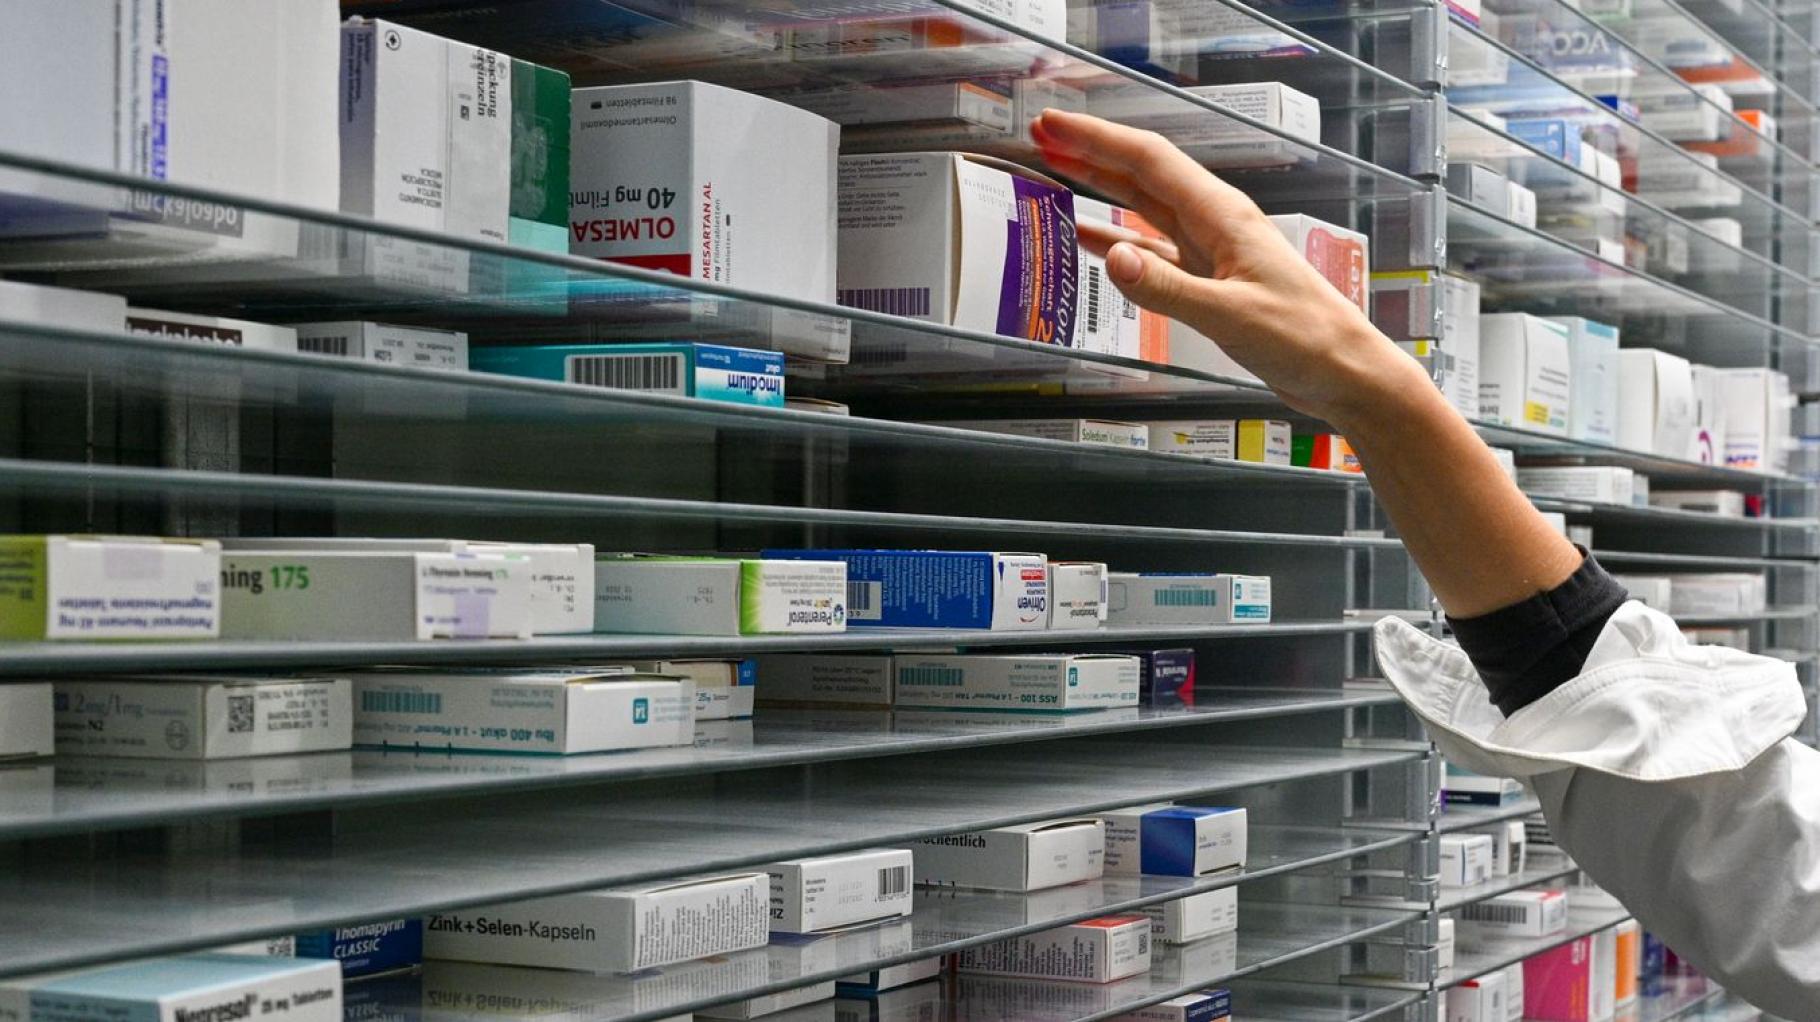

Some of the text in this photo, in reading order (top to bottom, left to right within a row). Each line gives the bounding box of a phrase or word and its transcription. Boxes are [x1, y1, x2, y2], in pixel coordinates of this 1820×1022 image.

[606, 96, 663, 108] Filmtabletten
[615, 185, 641, 203] mg
[646, 186, 676, 209] 40
[573, 217, 676, 241] OLMESA
[702, 181, 713, 279] MESARTAN AL
[1036, 195, 1055, 344] Schwangerschaft 2
[1050, 193, 1077, 347] femibion
[727, 374, 781, 396] Imodium
[1081, 427, 1108, 442] Soledum
[269, 564, 311, 590] 175
[787, 611, 833, 627] Perenterol
[1019, 693, 1037, 704] 100
[1038, 693, 1058, 703] ASS
[87, 719, 105, 732] N2
[480, 726, 508, 740] akut
[510, 727, 533, 742] 400
[535, 728, 554, 743] Ibu
[918, 834, 986, 849] chentlich
[428, 914, 596, 945] Zink+Selen-Kapseln
[333, 937, 381, 959] CLASSIC
